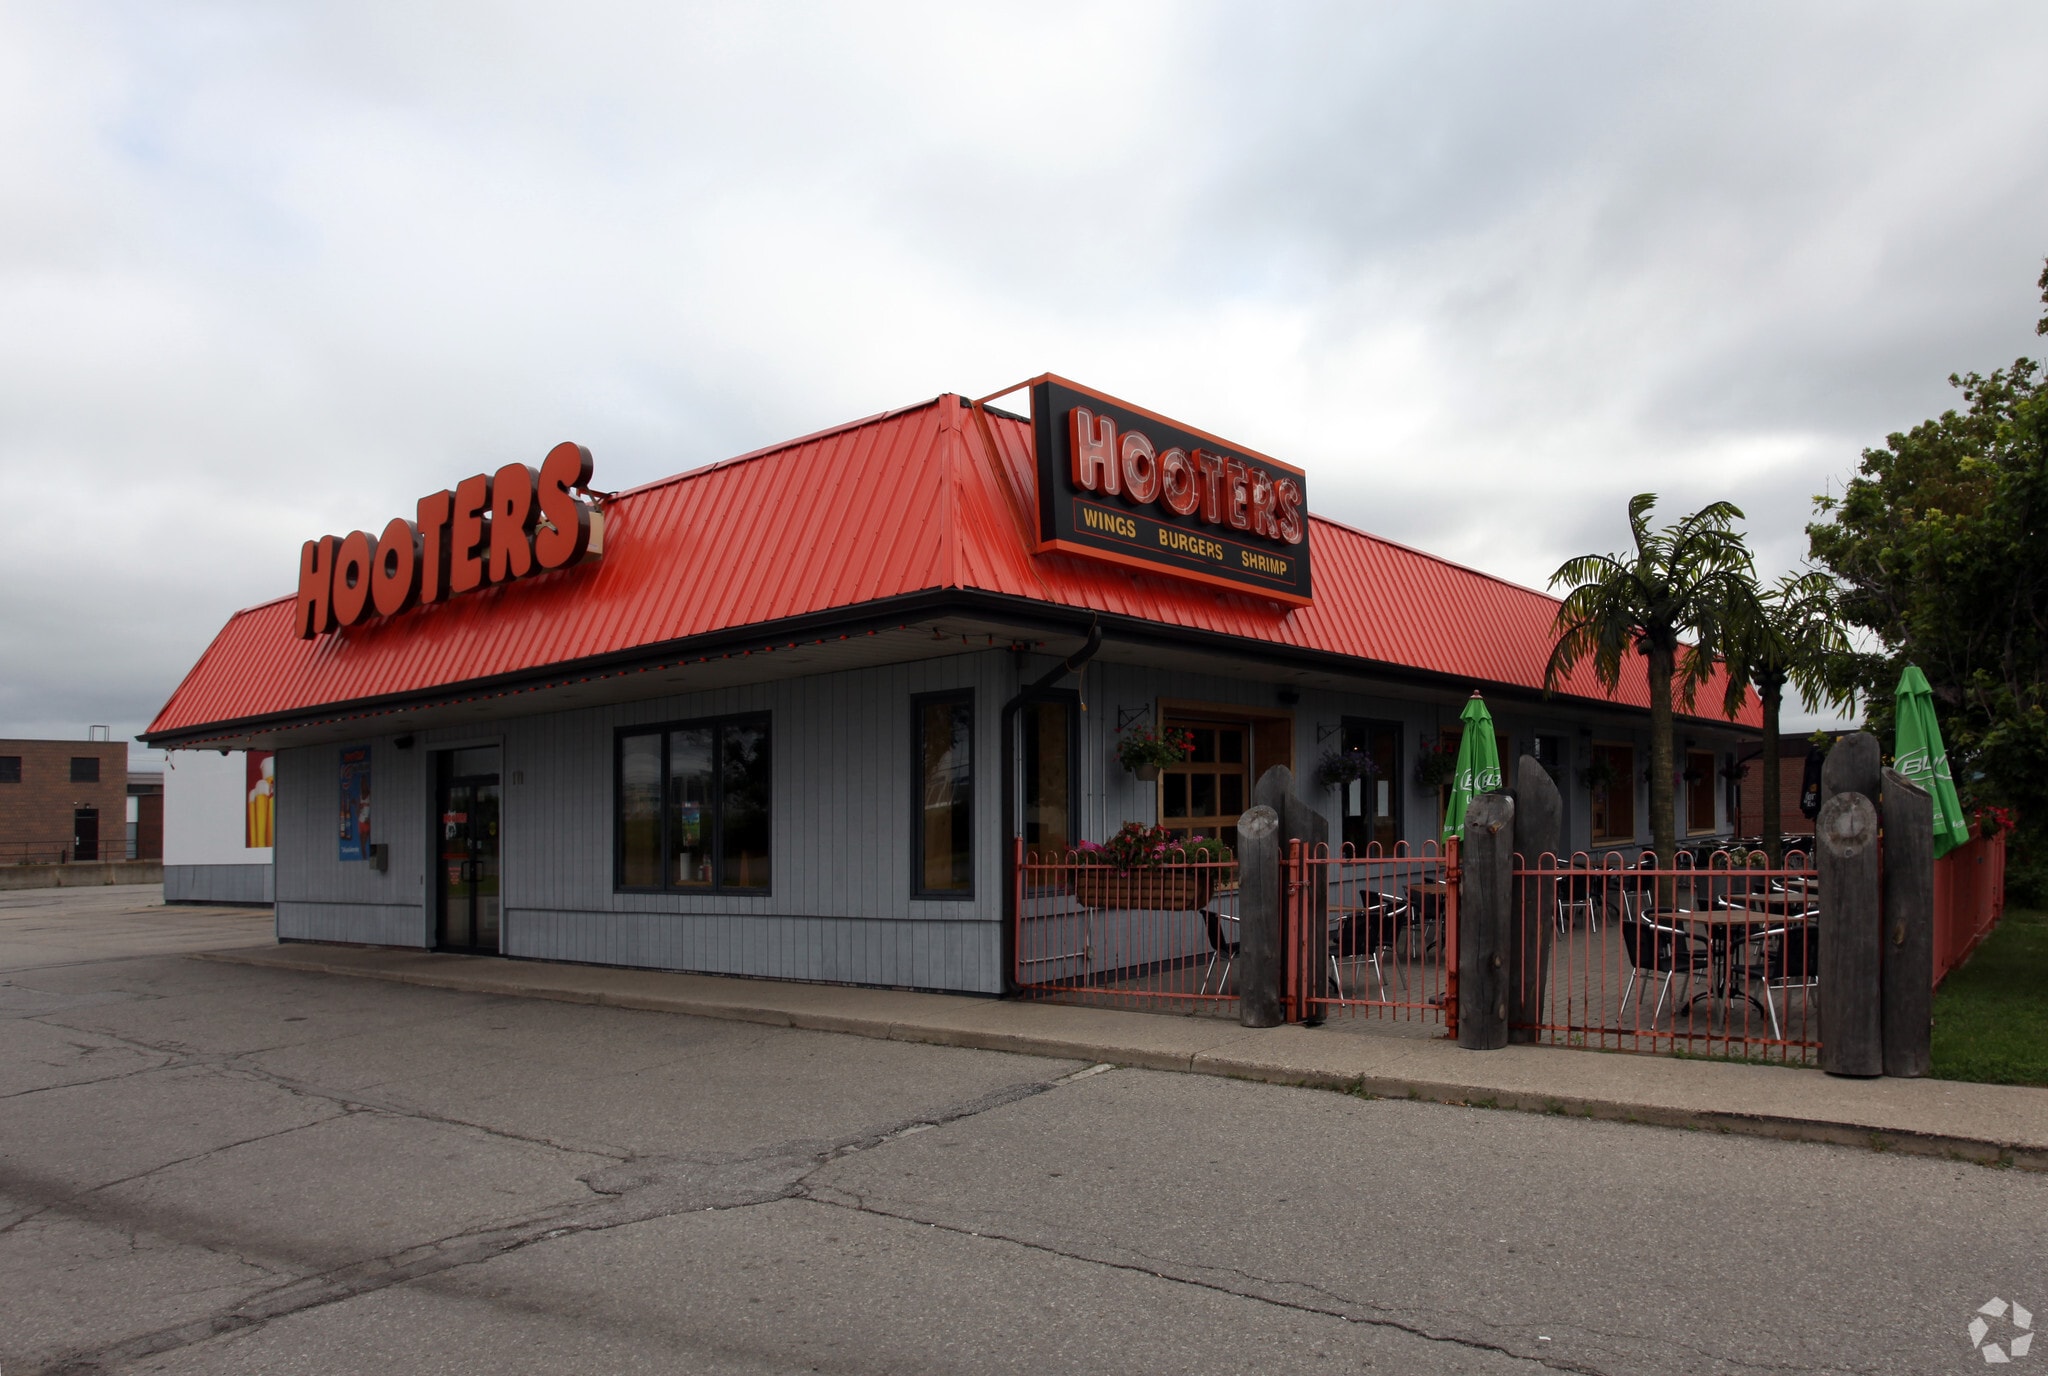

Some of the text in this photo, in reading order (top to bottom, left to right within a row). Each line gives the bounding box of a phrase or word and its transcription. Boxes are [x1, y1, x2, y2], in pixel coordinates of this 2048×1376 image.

[296, 441, 593, 641] HOOTERS
[1069, 406, 1303, 545] HOOTERS
[1083, 507, 1288, 576] WINGS BURGERS SHRIMP
